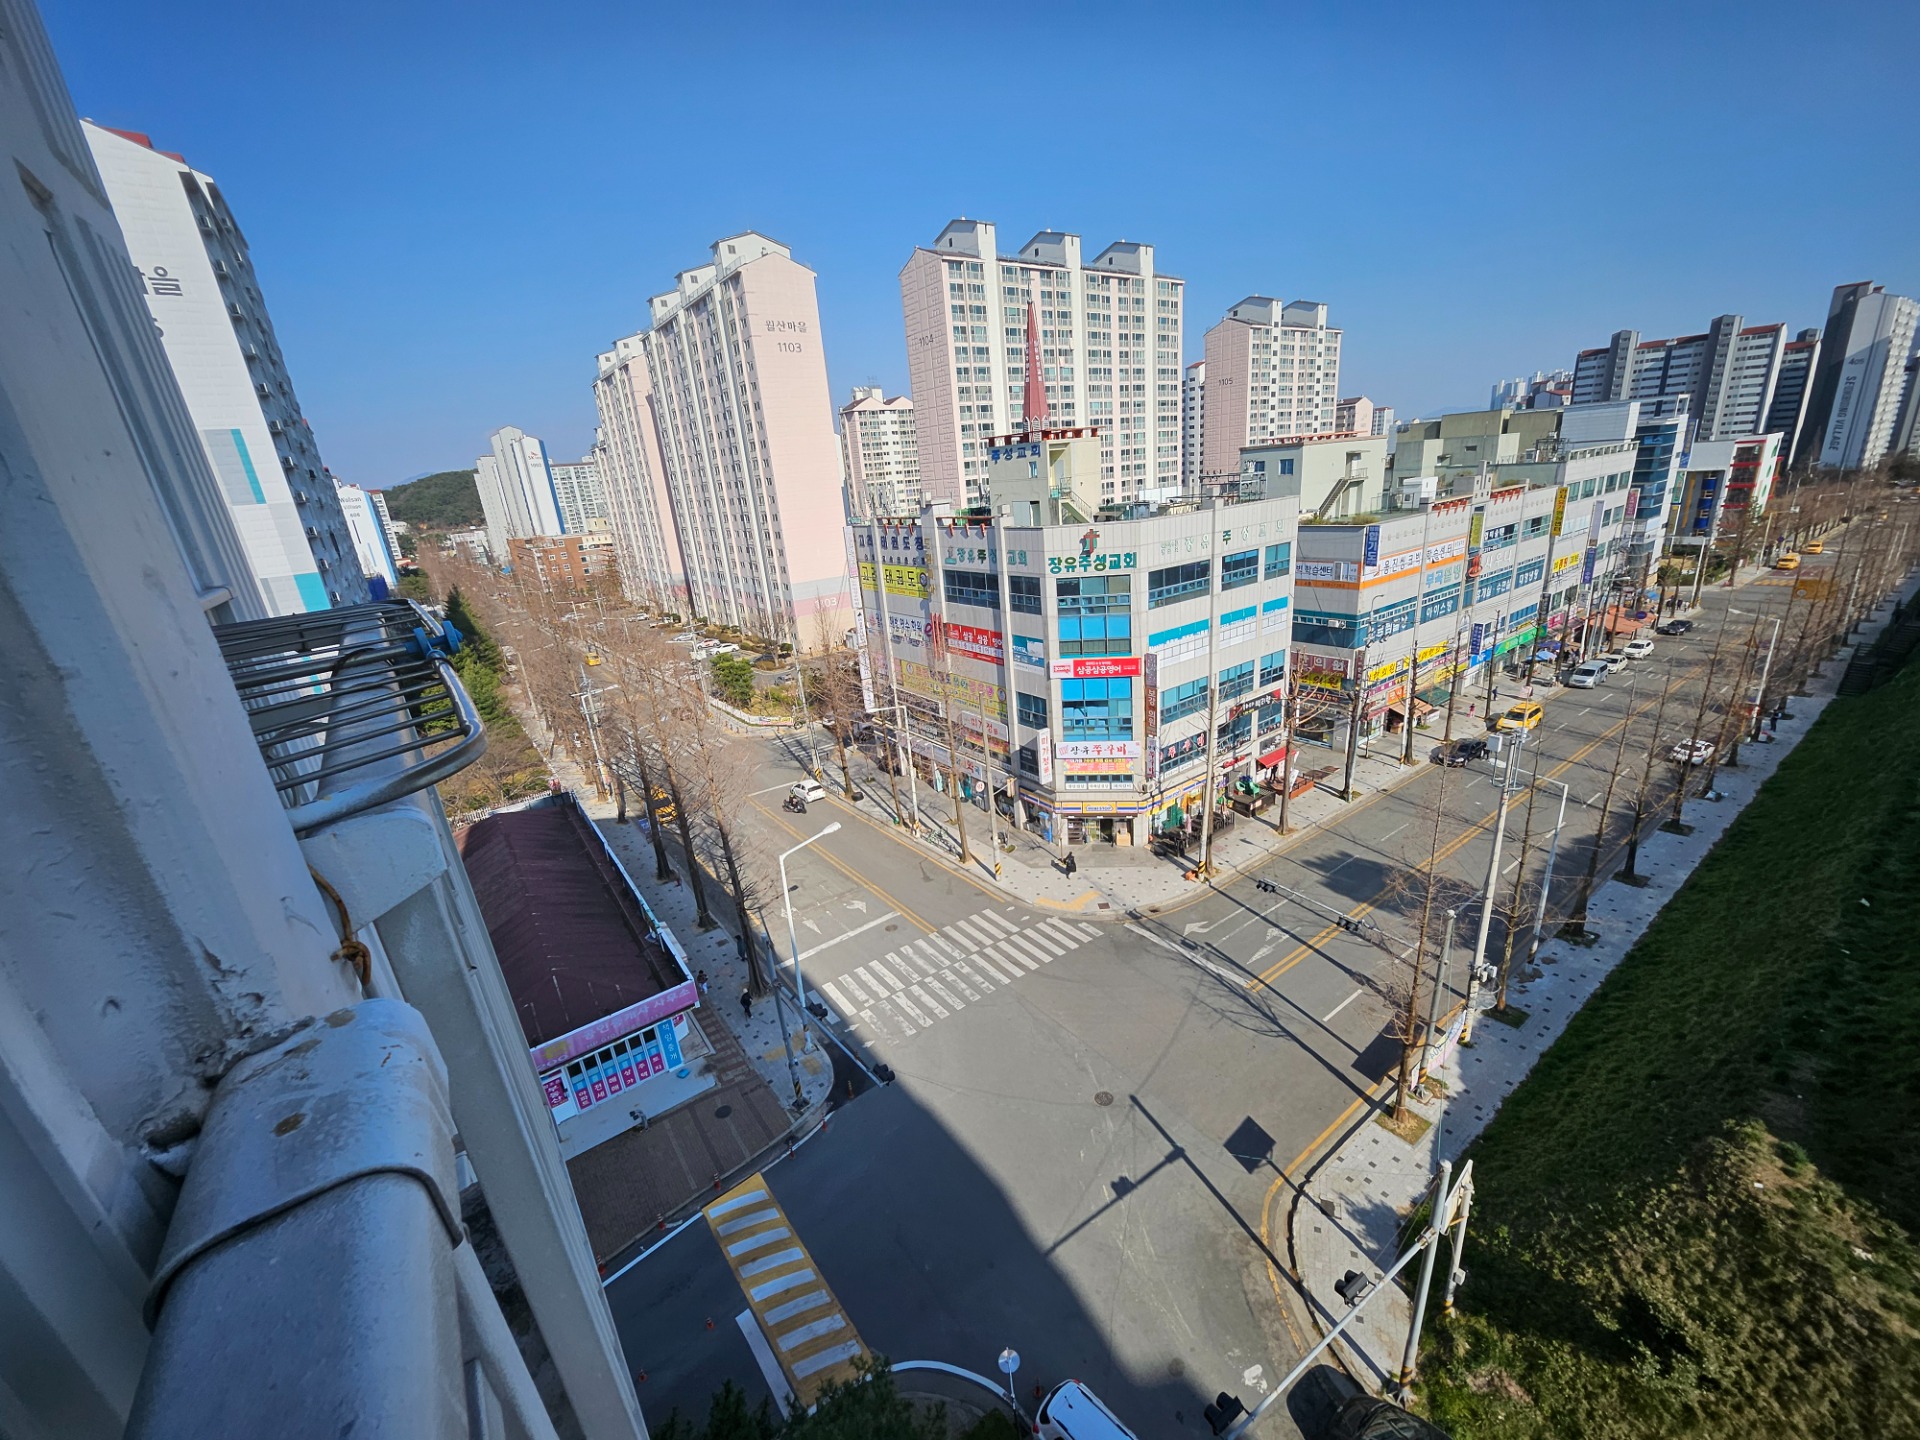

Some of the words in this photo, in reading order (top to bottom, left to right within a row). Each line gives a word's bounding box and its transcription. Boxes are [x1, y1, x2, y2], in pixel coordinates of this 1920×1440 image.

[765, 320, 807, 333] 월산마을
[777, 342, 802, 353] 1103
[991, 445, 1041, 464] 주성교회
[1367, 530, 1379, 561] 합기도
[1048, 552, 1137, 574] 장유주성교회
[1076, 664, 1122, 676] 삼공삼공영어
